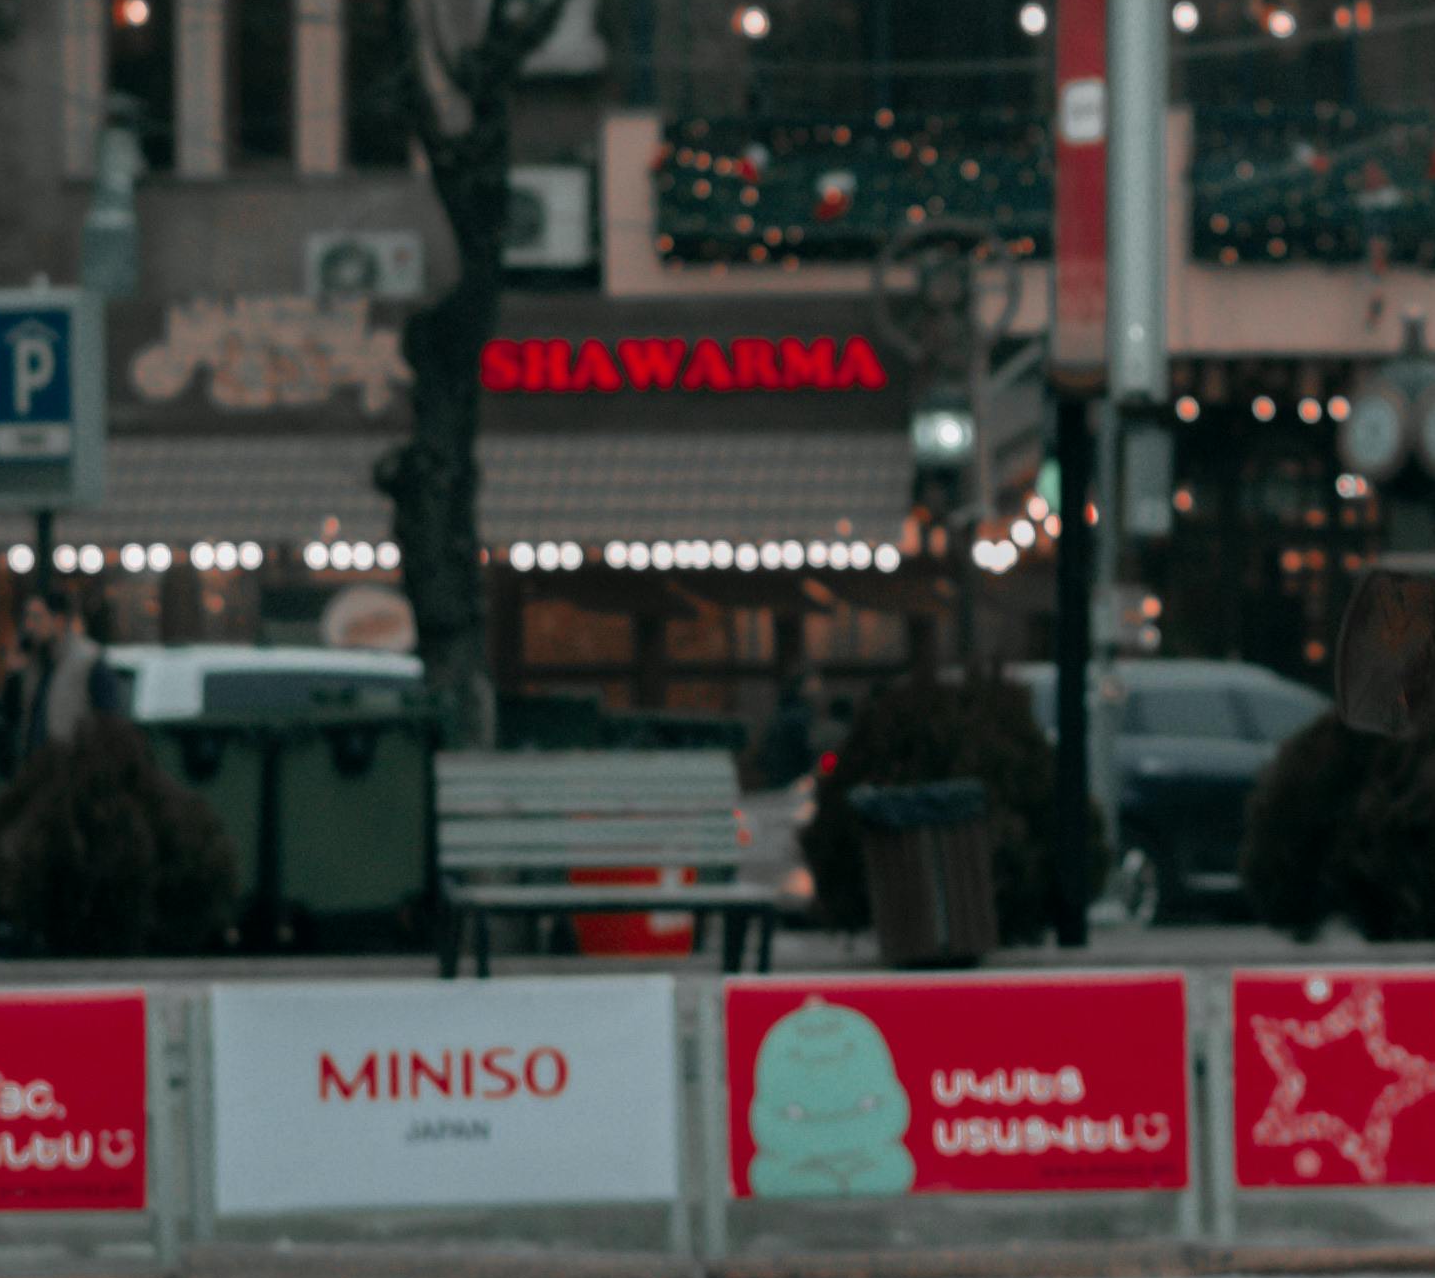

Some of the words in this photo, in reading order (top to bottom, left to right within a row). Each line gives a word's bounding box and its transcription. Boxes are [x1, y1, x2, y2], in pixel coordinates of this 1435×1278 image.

[13, 338, 56, 413] P
[480, 337, 888, 392] SHAWARMA
[318, 1045, 570, 1102] MINISO
